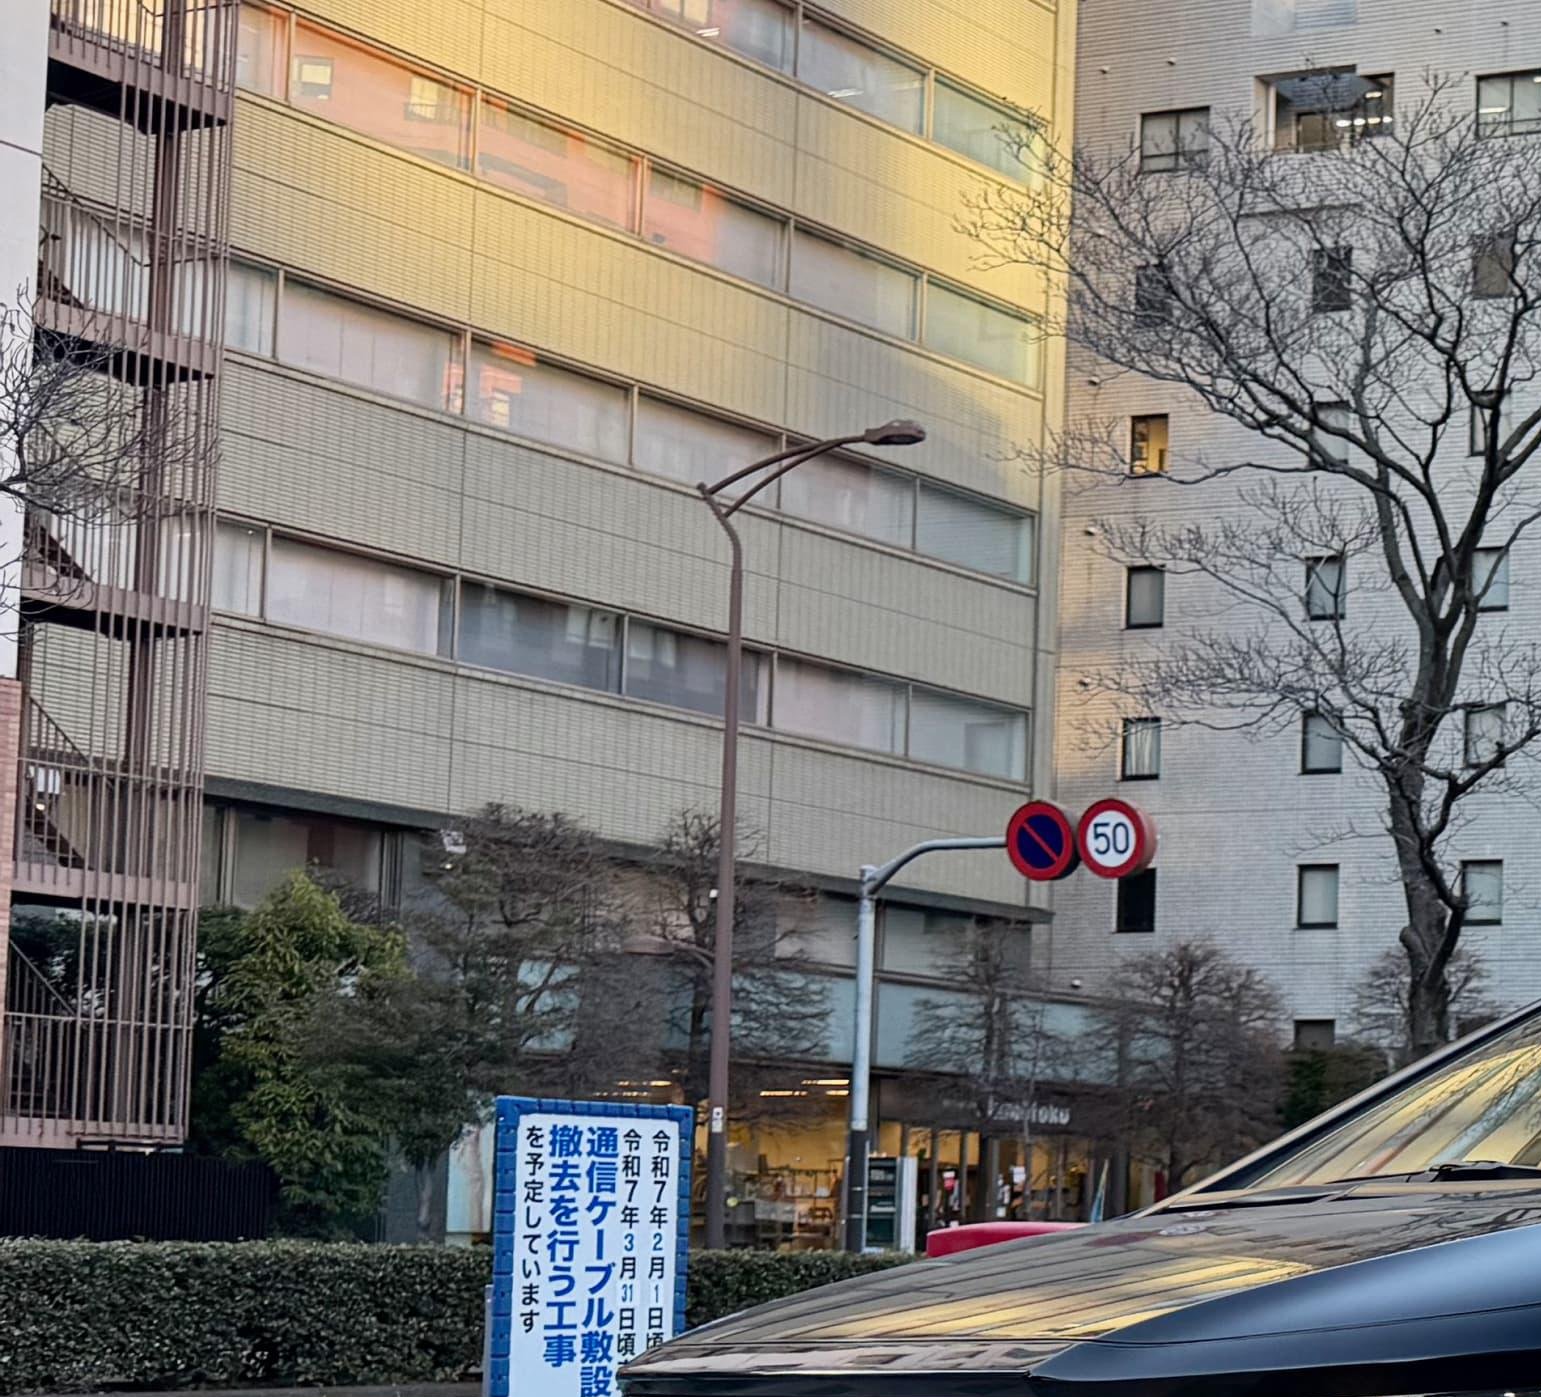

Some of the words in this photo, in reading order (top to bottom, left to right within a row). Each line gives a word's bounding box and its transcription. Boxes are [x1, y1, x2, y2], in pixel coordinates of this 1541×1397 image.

[1093, 822, 1130, 855] 50
[520, 1125, 545, 1334] を予定しています
[543, 1125, 583, 1368] 撤去を行う工事
[617, 1128, 642, 1366] 令和7年3月31日頃
